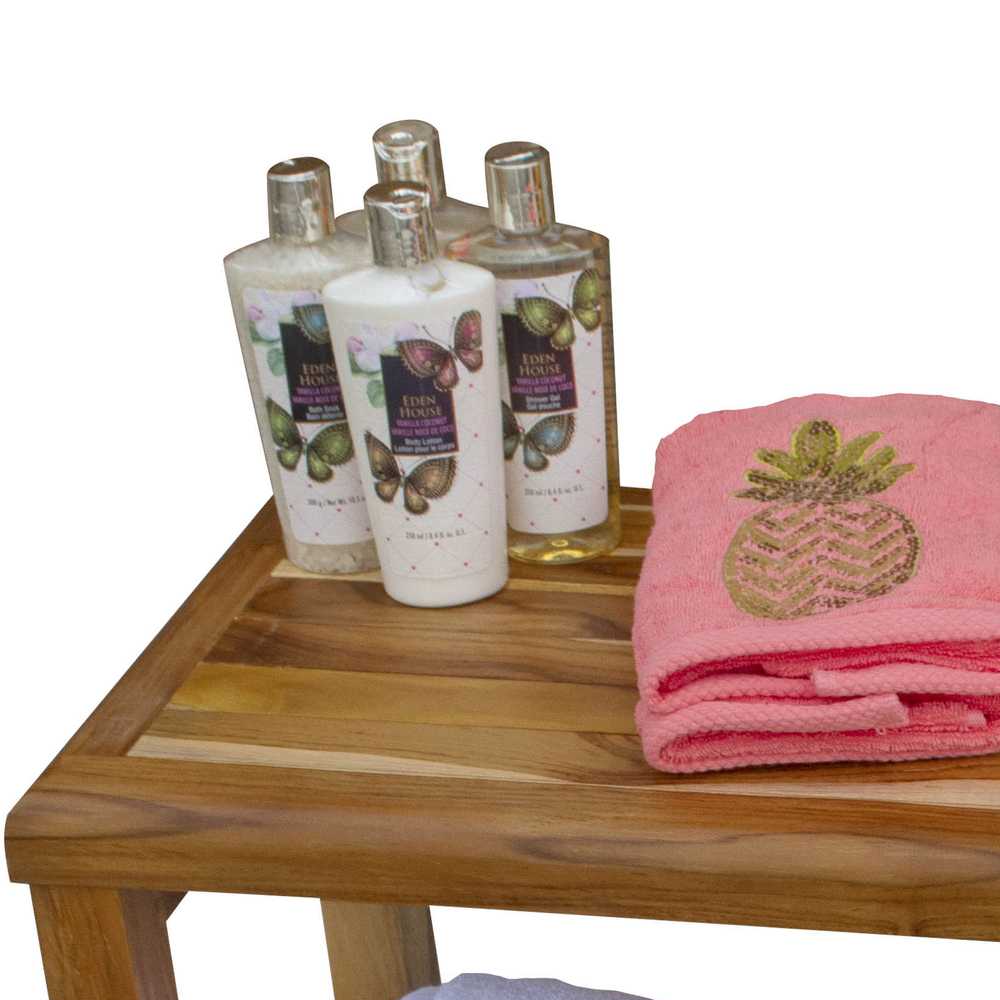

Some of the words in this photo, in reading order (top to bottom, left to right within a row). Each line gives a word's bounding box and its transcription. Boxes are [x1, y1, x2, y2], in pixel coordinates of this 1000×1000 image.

[522, 353, 556, 365] EDEN
[519, 364, 561, 376] HOUSE
[299, 374, 338, 386] HOUS
[402, 394, 436, 407] EDEN
[400, 406, 442, 418] HOUSE
